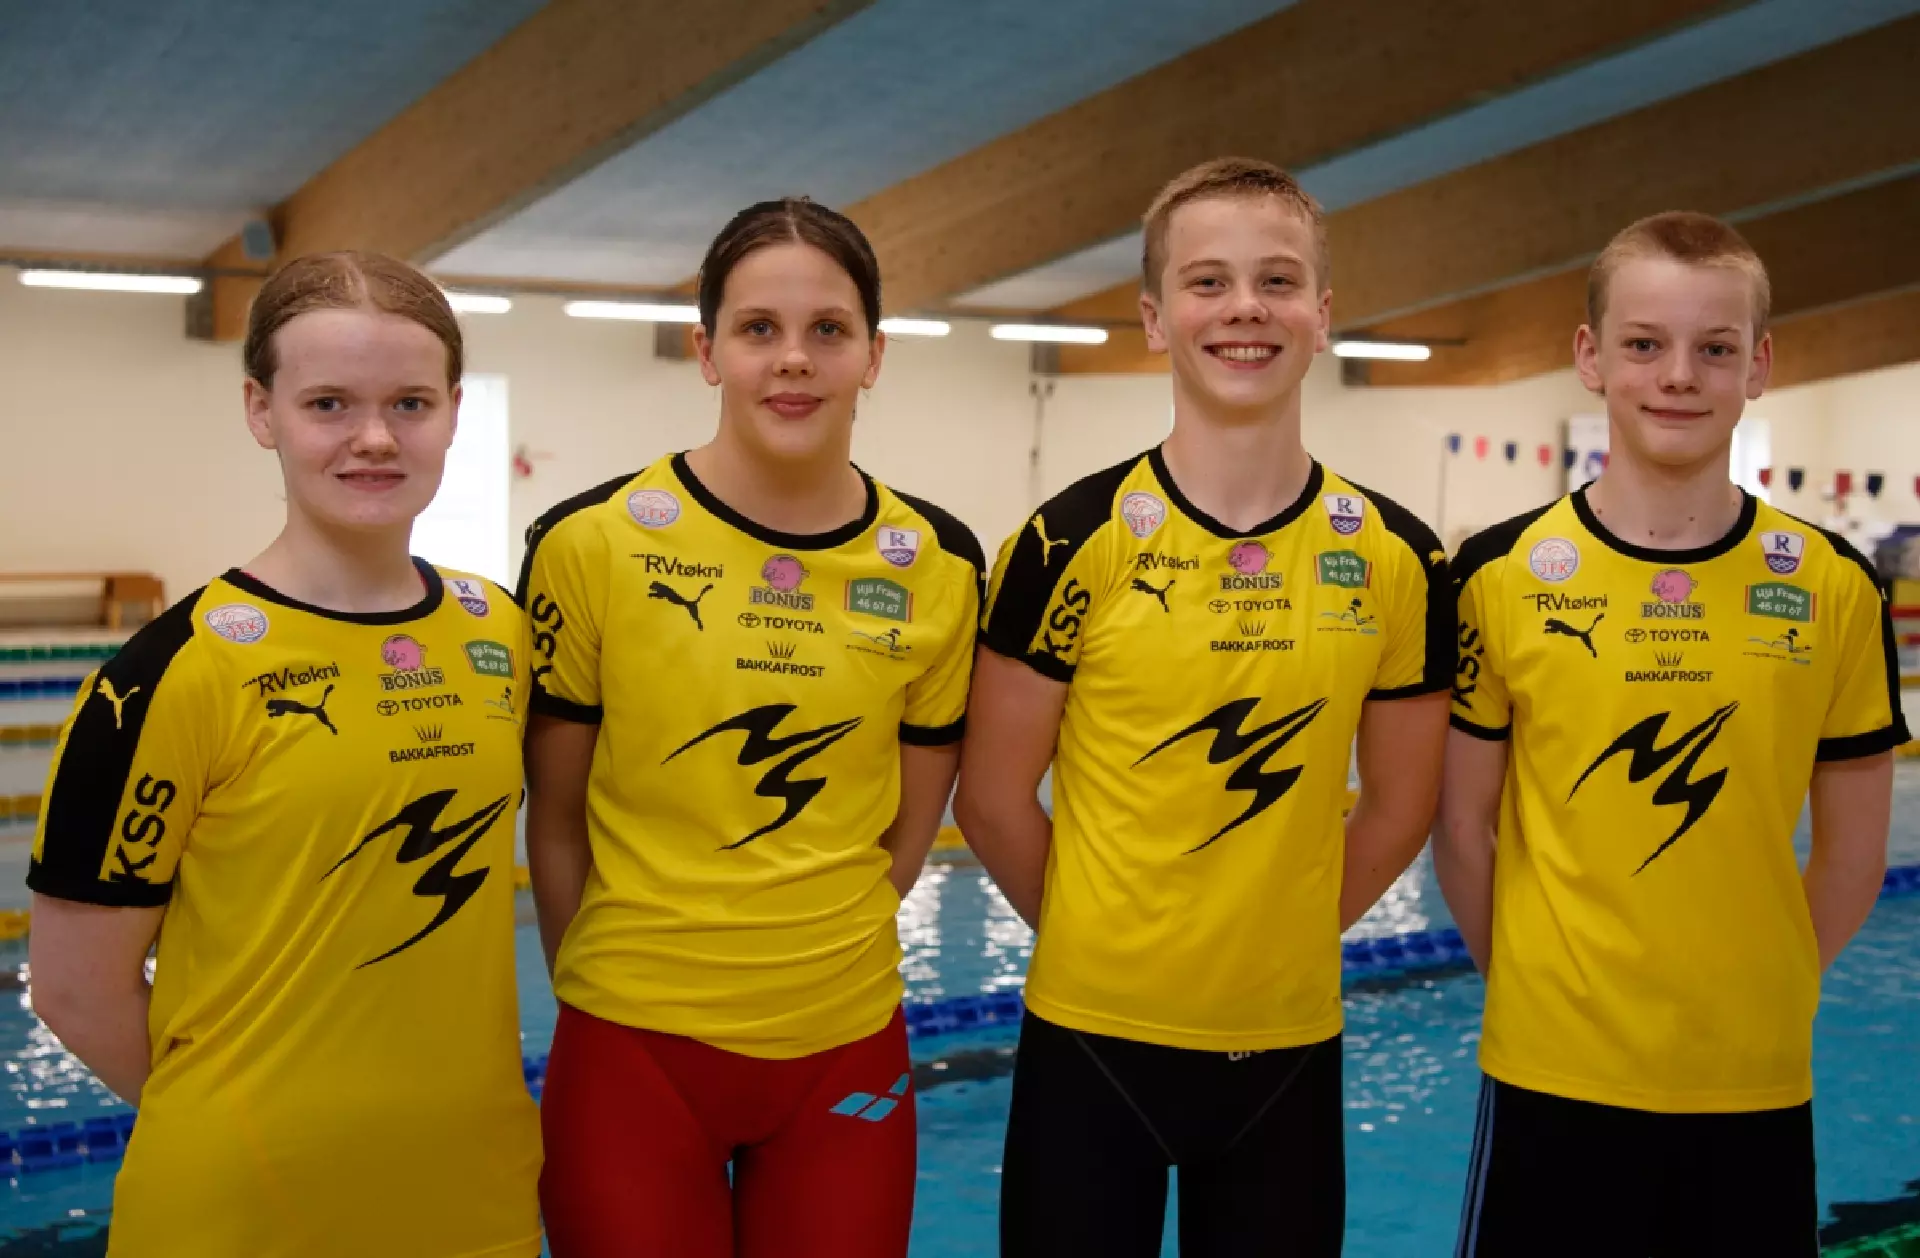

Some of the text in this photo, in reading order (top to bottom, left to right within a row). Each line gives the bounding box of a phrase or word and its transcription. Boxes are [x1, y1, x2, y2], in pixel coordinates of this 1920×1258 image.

[1337, 498, 1354, 514] R
[890, 532, 907, 546] R
[1774, 535, 1791, 553] R
[1234, 598, 1292, 611] TOYOTA
[764, 617, 825, 633] TOYOTA
[1036, 578, 1091, 663] KSS
[1649, 629, 1710, 642] TOYOTA
[1211, 639, 1296, 652] BAKKAFROST
[736, 658, 826, 677] BAKKAFROST
[1625, 670, 1714, 682] BAKKAFROST
[401, 693, 463, 711] TOYOTA
[389, 742, 475, 763] BAKKAFROST
[109, 771, 177, 885] KSS
